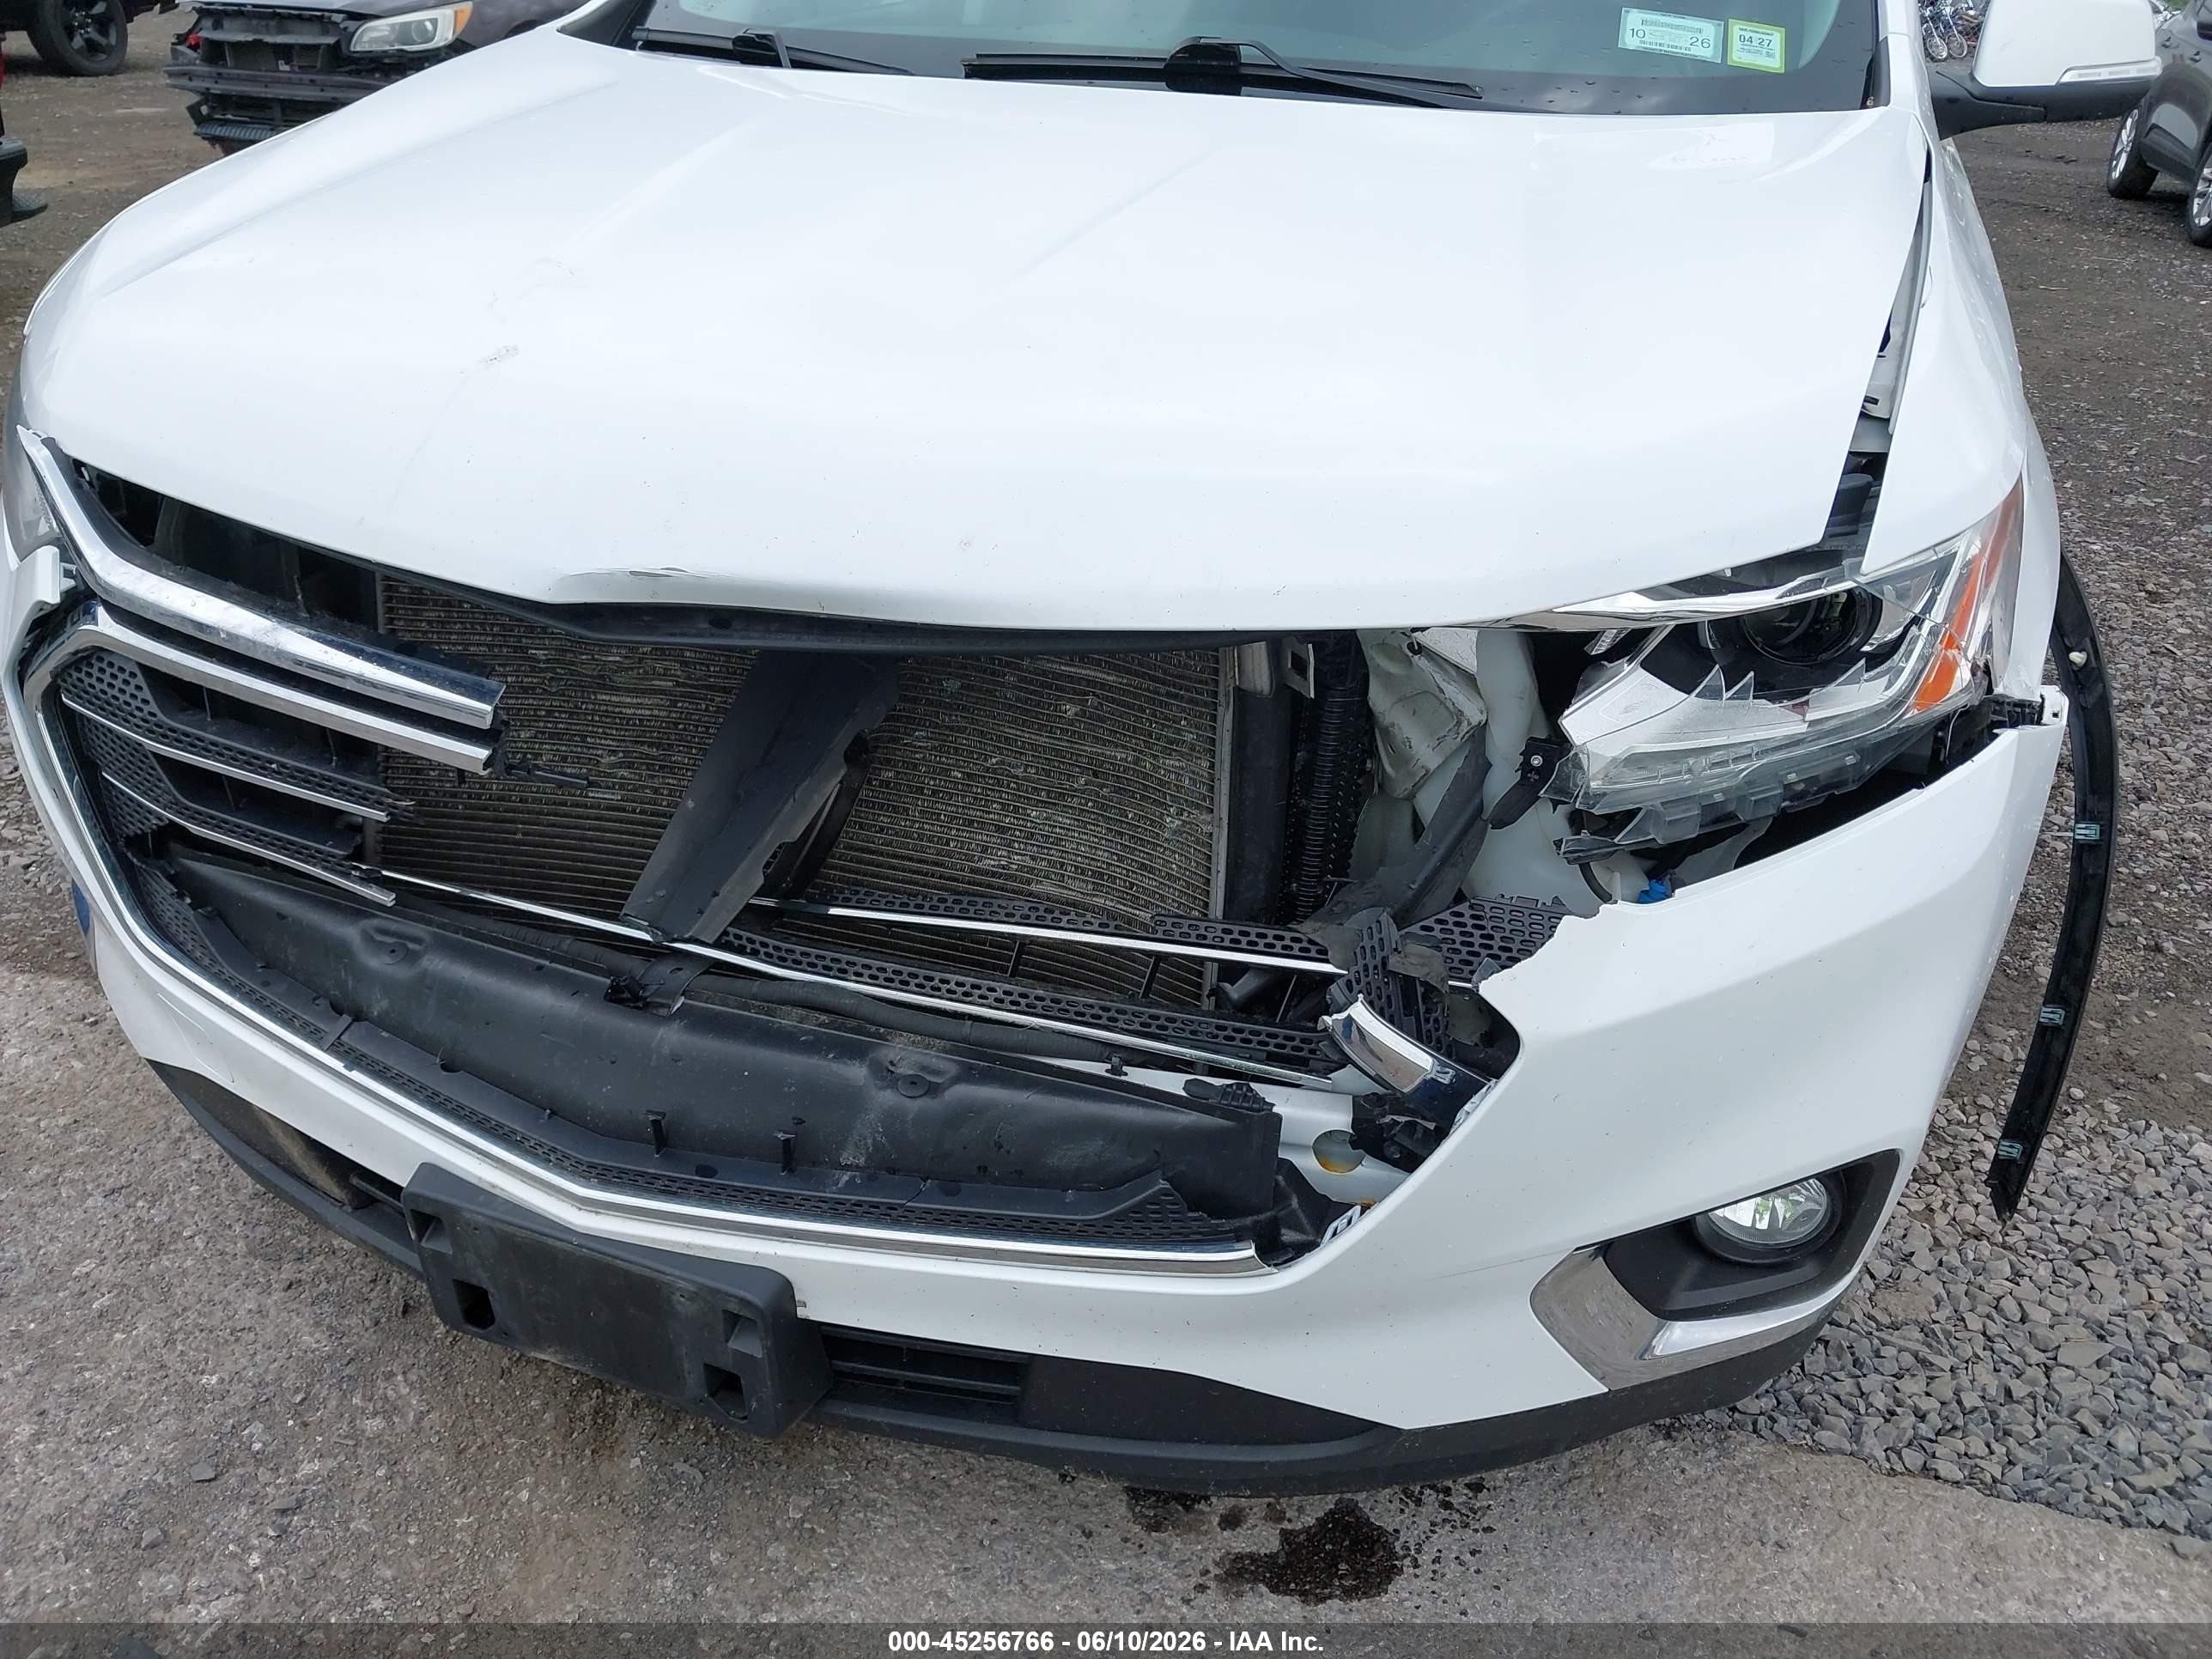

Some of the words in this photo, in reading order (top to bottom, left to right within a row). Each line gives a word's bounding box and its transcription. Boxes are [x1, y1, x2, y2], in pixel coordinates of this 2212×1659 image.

[1629, 27, 1646, 40] 10
[1689, 36, 1711, 49] 26
[1739, 33, 1753, 45] 04
[1758, 37, 1773, 47] 27
